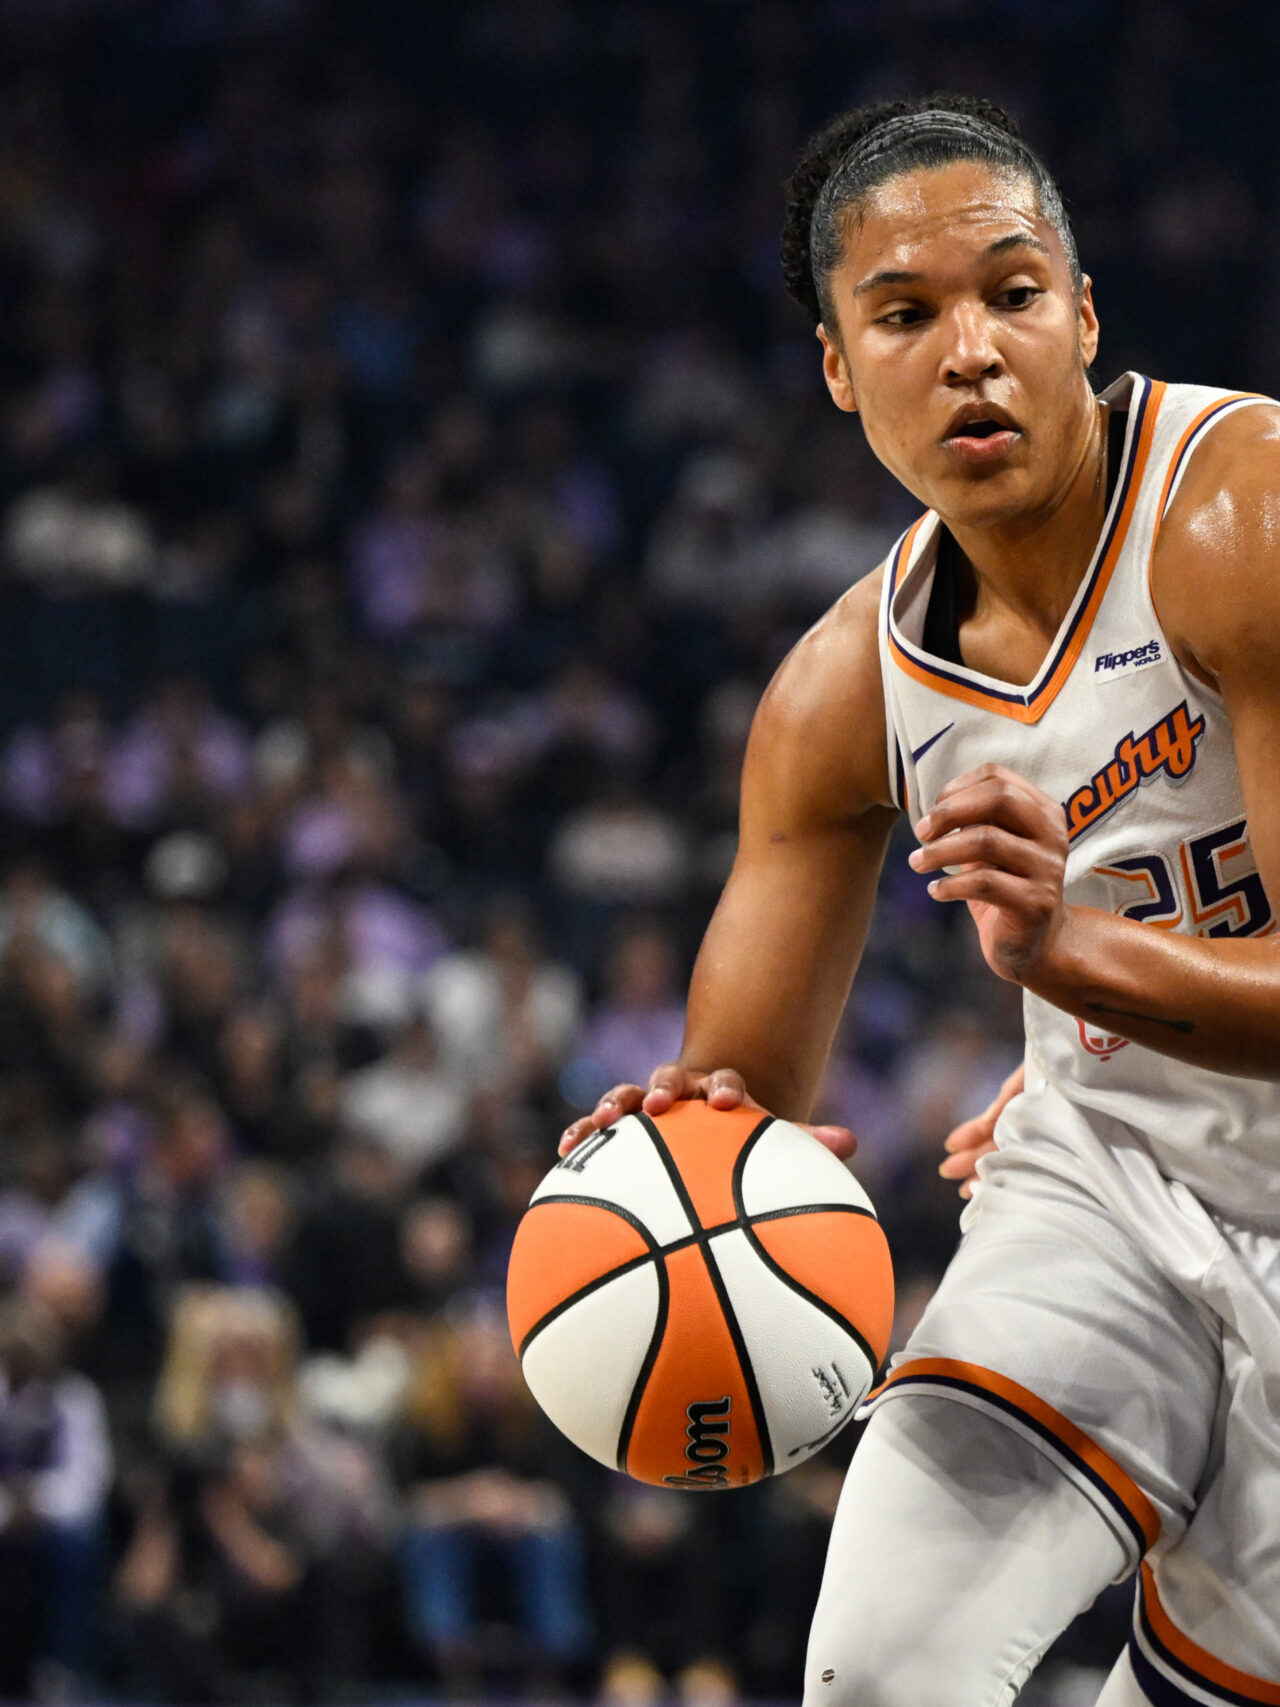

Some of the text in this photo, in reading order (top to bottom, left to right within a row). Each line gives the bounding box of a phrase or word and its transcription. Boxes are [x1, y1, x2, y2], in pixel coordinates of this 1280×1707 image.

[1094, 639, 1160, 672] Flipper's
[1134, 653, 1161, 667] WORLD
[1061, 698, 1206, 844] cury
[1090, 815, 1276, 938] 25
[662, 1395, 731, 1489] lson
